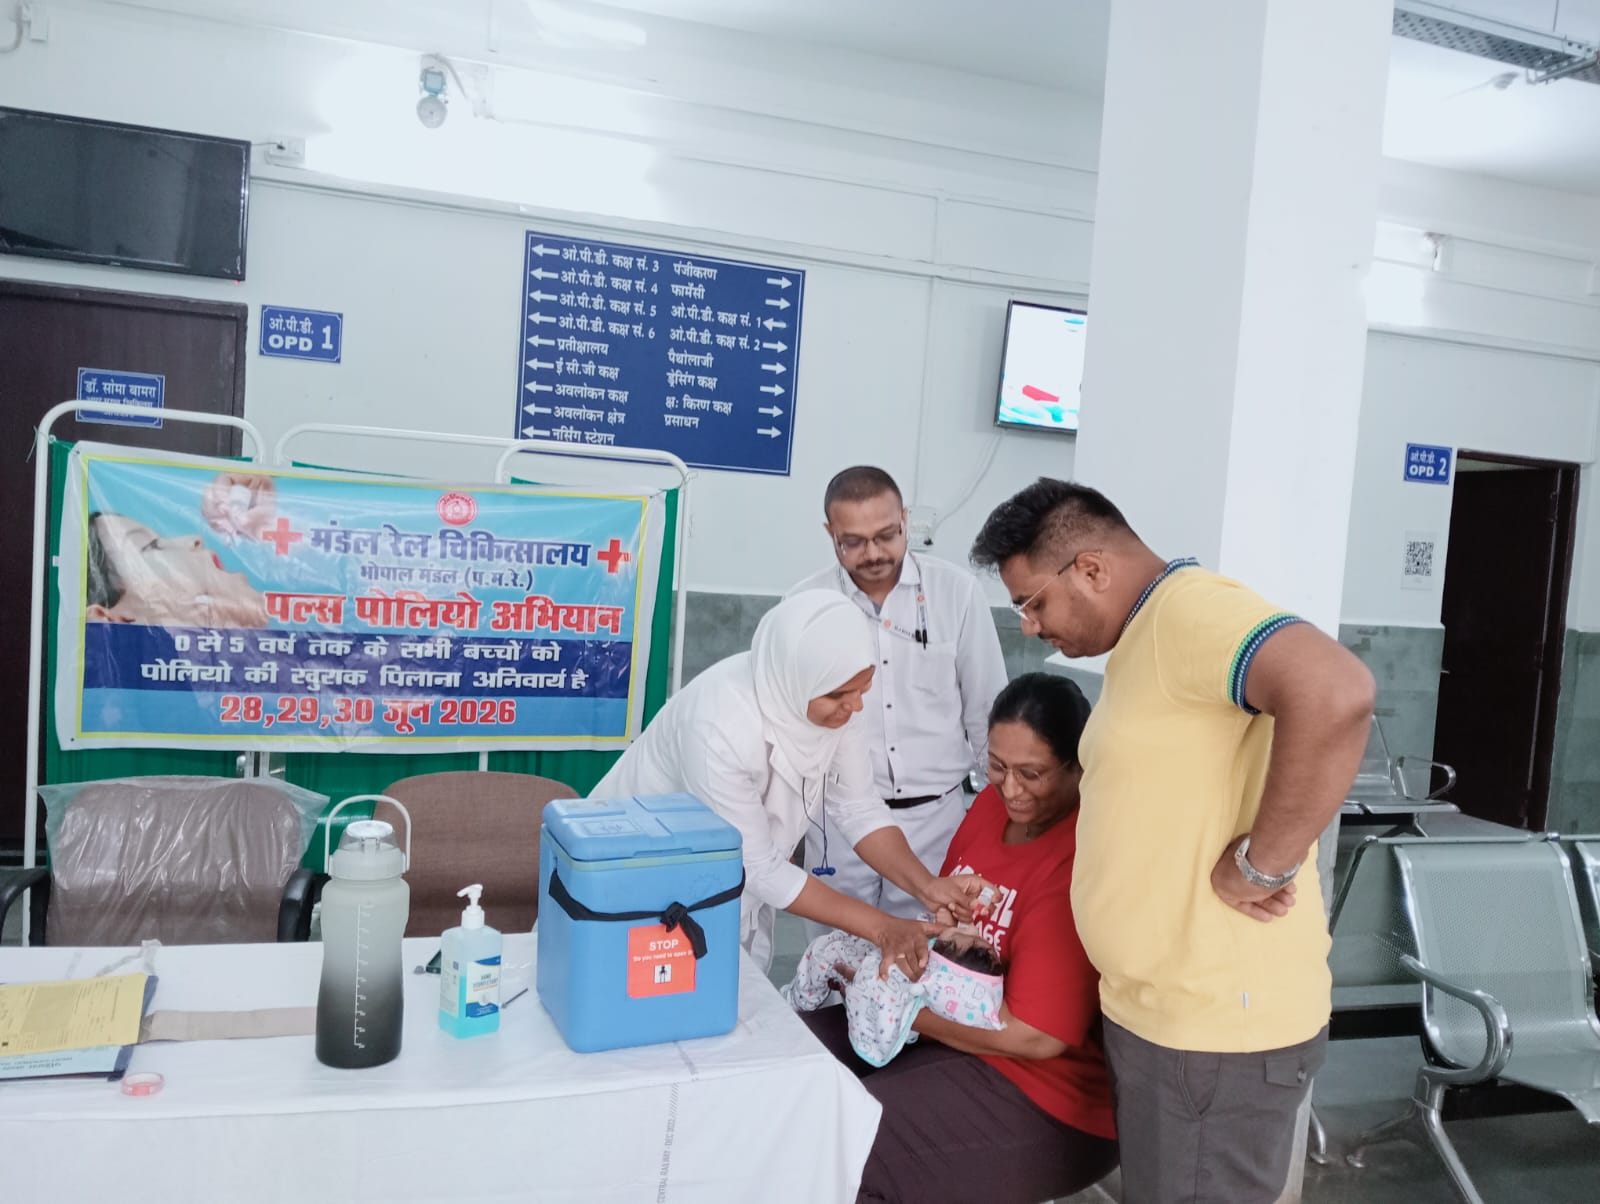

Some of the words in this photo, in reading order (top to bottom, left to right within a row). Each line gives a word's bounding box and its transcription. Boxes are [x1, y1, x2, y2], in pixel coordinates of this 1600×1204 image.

[561, 245, 609, 266] ओ.पी.डी.
[612, 254, 633, 271] कक्ष
[637, 254, 648, 272] सं.
[652, 261, 659, 273] 3
[673, 261, 718, 280] पंजीकरण
[560, 268, 608, 289] ओ.पी.डी.
[611, 277, 632, 294] कक्ष
[635, 278, 647, 293] सं.
[650, 283, 658, 295] 4
[559, 290, 606, 311] ओ.पी.डी.
[609, 299, 630, 316] कक्ष
[634, 300, 645, 316] सं.
[650, 305, 657, 317] 5
[269, 314, 314, 334] ओ.पी.डी.
[558, 313, 605, 333] ओ.पी.डी.
[608, 322, 629, 338] कक्ष
[632, 323, 644, 338] सं.
[648, 328, 655, 340] 6
[671, 303, 714, 321] ओ.पी.डी.
[717, 311, 737, 326] कक्ष
[740, 312, 751, 327] सं.
[756, 317, 761, 328] 1
[268, 334, 313, 351] OPD
[321, 325, 333, 350] 1
[557, 336, 609, 356] प्रतीक्षालय
[670, 326, 713, 345] ओ.पी.डी.
[716, 333, 735, 348] कक्ष
[739, 335, 750, 349] सं.
[754, 340, 760, 351] 2
[566, 358, 596, 377] सी.जी
[598, 365, 620, 382] कक्ष
[83, 378, 98, 393] डॉ.
[102, 378, 127, 395] सोमा
[555, 383, 605, 400] अवलोकन
[608, 389, 629, 405] कक्ष
[697, 376, 718, 392] कक्ष
[553, 405, 604, 422] अवलोकन
[607, 408, 626, 425] क्षेत्र
[683, 394, 710, 411] किरण
[712, 400, 733, 416] कक्ष
[664, 414, 699, 428] प्रसाधन
[552, 425, 582, 442] नर्सिंग
[584, 428, 615, 445] स्टेशन
[1409, 464, 1435, 477] OPD
[1438, 458, 1447, 476] 2
[311, 520, 381, 556] मंडल
[383, 524, 432, 558] रेल
[440, 529, 591, 567] चिकित्सालय
[360, 561, 414, 581] भोपाल
[419, 564, 458, 584] मंडल
[264, 592, 346, 625] पल्स
[355, 588, 482, 630] पोलियो
[491, 595, 624, 634] अभियान
[175, 635, 190, 651] 0
[197, 630, 224, 653] से
[229, 636, 245, 653] 5
[258, 633, 297, 655] वर्ष
[308, 639, 353, 656] तक
[363, 636, 389, 657] के
[401, 638, 453, 659] सभी
[463, 640, 522, 661] बच्चों
[531, 642, 562, 662] को
[140, 658, 233, 683] पोलियो
[244, 661, 279, 684] की
[290, 668, 368, 691] खुराक
[380, 665, 462, 688] पिलाना
[473, 667, 567, 689] अनिवार्य
[571, 668, 589, 690] है
[220, 696, 374, 728] 28,29,30
[383, 699, 434, 733] जून
[440, 699, 516, 724] 2026
[649, 939, 679, 952] STOP
